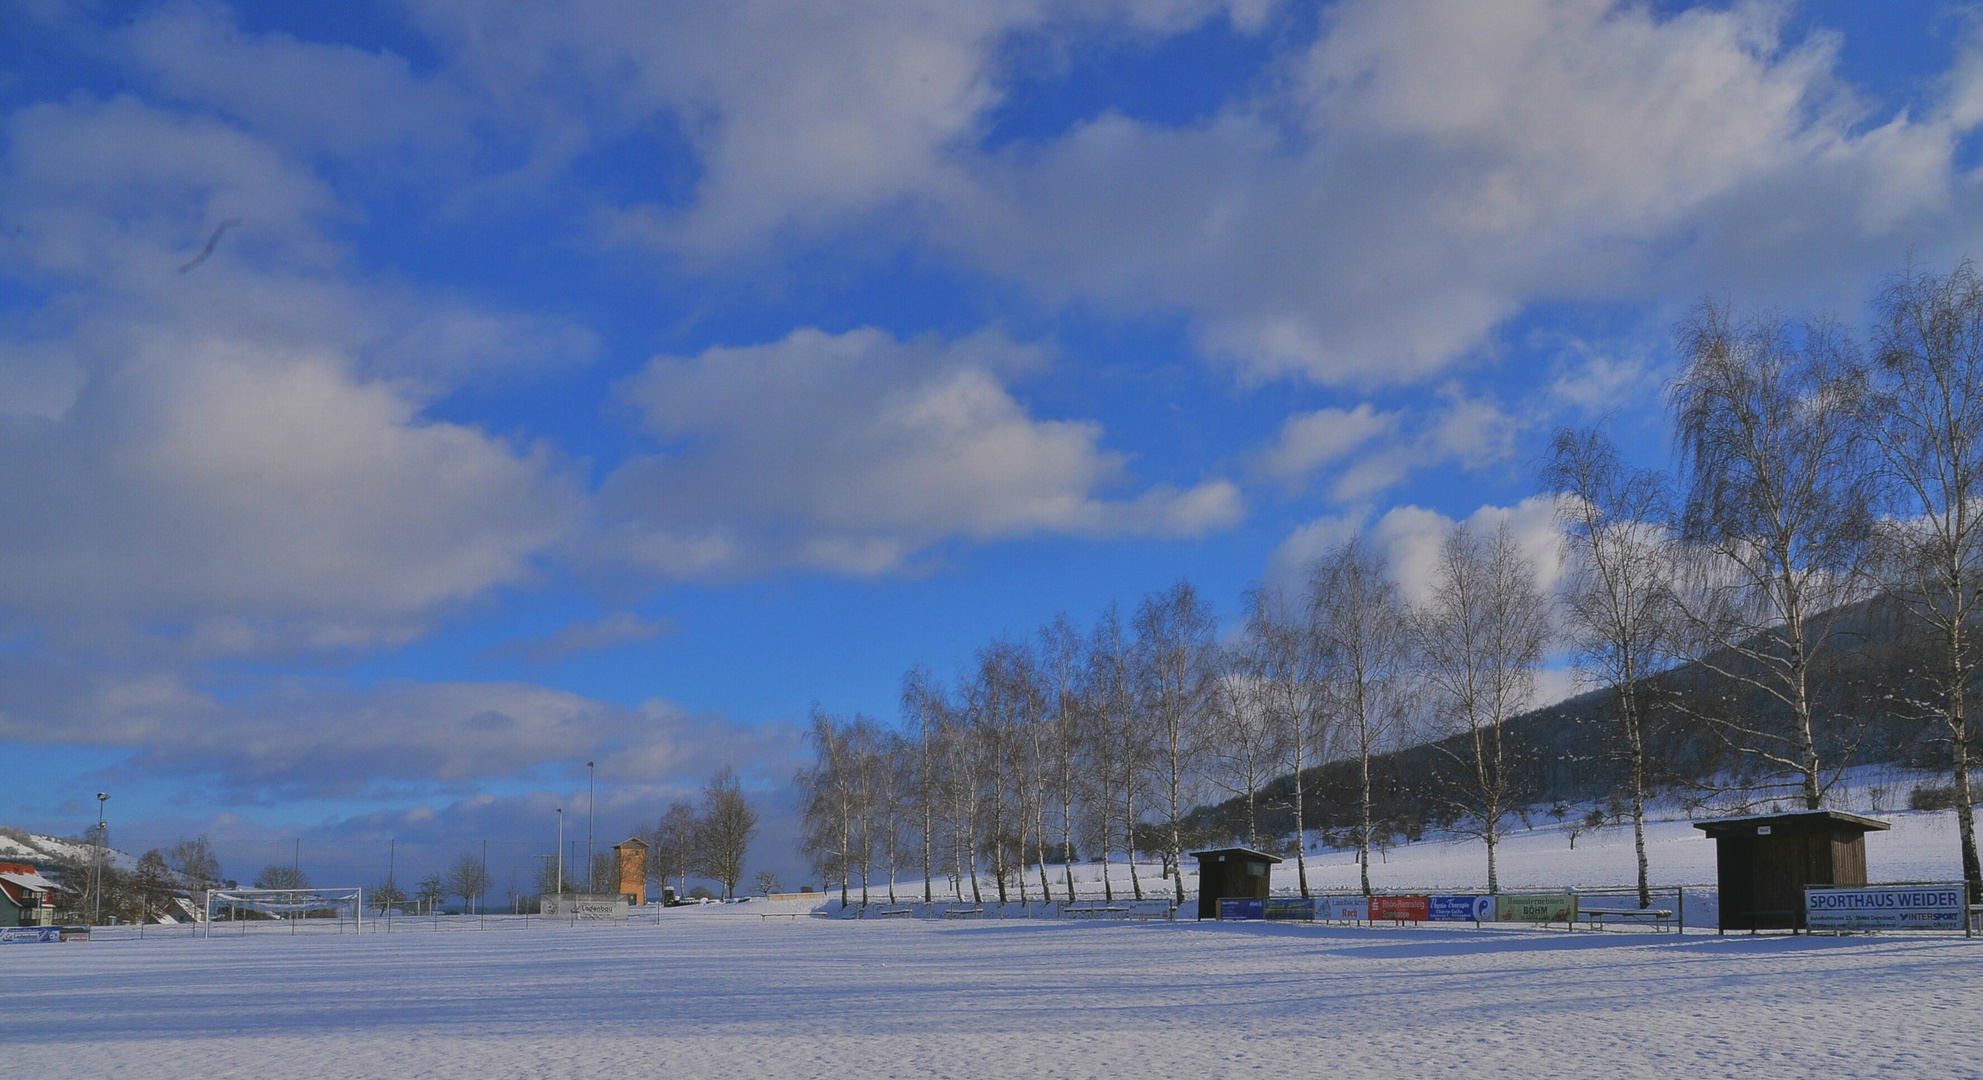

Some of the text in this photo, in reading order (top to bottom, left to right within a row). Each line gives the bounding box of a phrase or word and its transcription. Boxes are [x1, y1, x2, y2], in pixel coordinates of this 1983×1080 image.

[1382, 899, 1425, 910] Rhön-Rennsteig
[1507, 897, 1565, 905] Bauunternehmen
[1810, 893, 1957, 908] SPORTHAUS WEIDER
[581, 905, 613, 913] Ladenbau
[1523, 905, 1548, 914] BÖHM
[1382, 909, 1410, 919] Sparkasse
[1909, 912, 1958, 921] INTERSPORT
